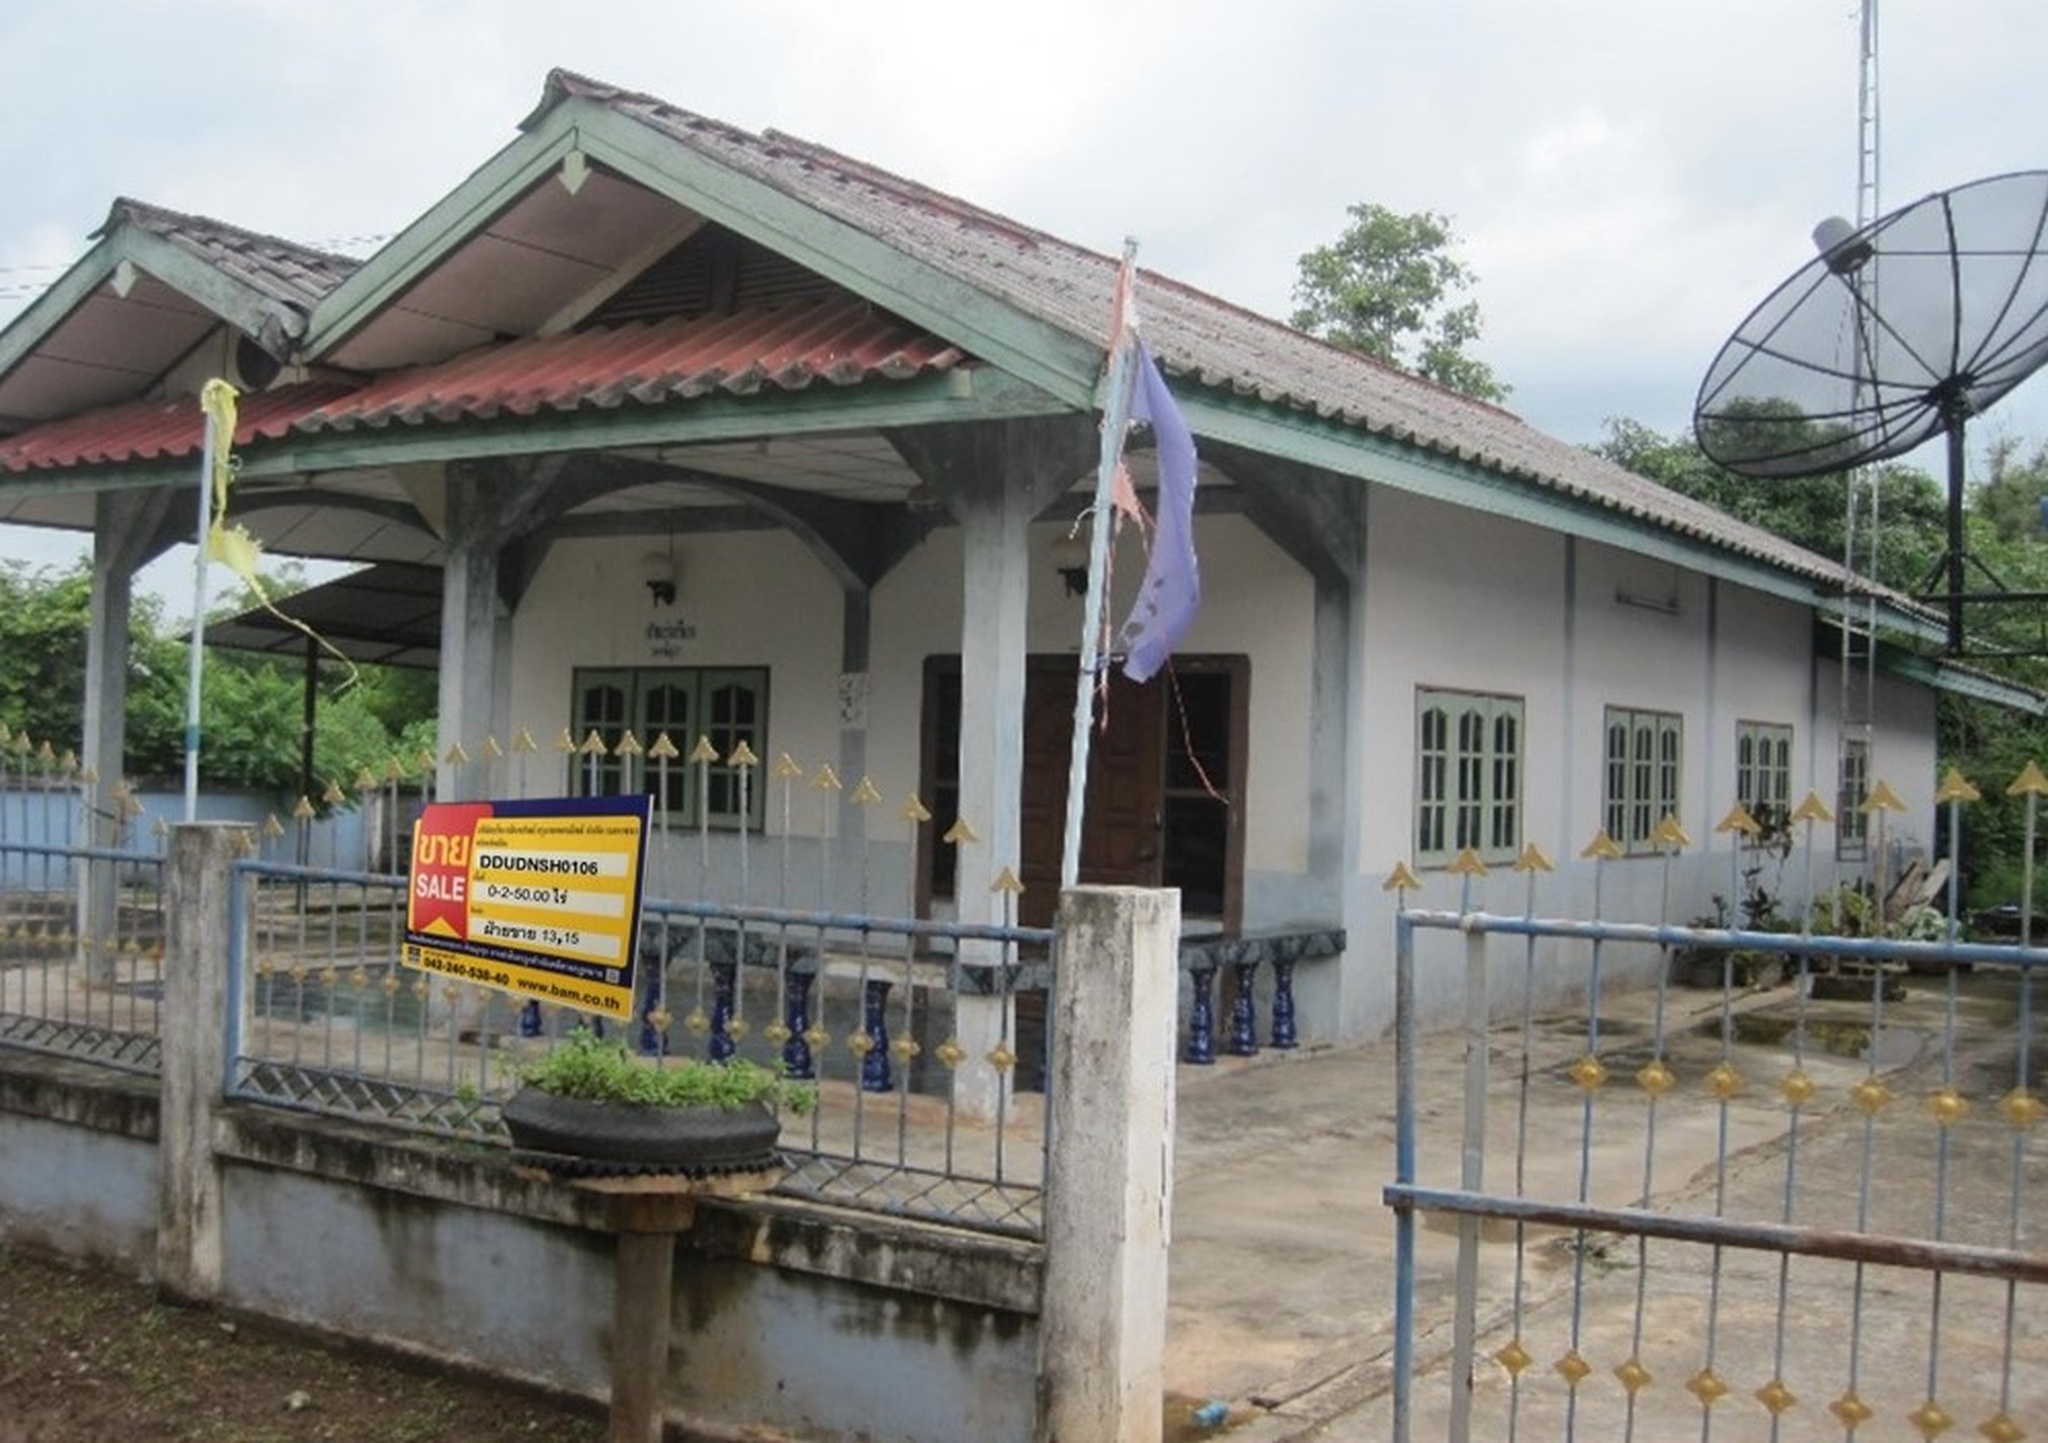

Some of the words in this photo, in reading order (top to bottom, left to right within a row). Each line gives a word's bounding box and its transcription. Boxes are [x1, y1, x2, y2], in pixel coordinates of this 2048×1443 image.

[419, 834, 469, 866] ขาย
[480, 854, 598, 875] DDUDNSH0106
[416, 873, 466, 902] SALE
[487, 884, 549, 903] 0-2-50.00
[518, 977, 619, 1009] www.bam.co.th
